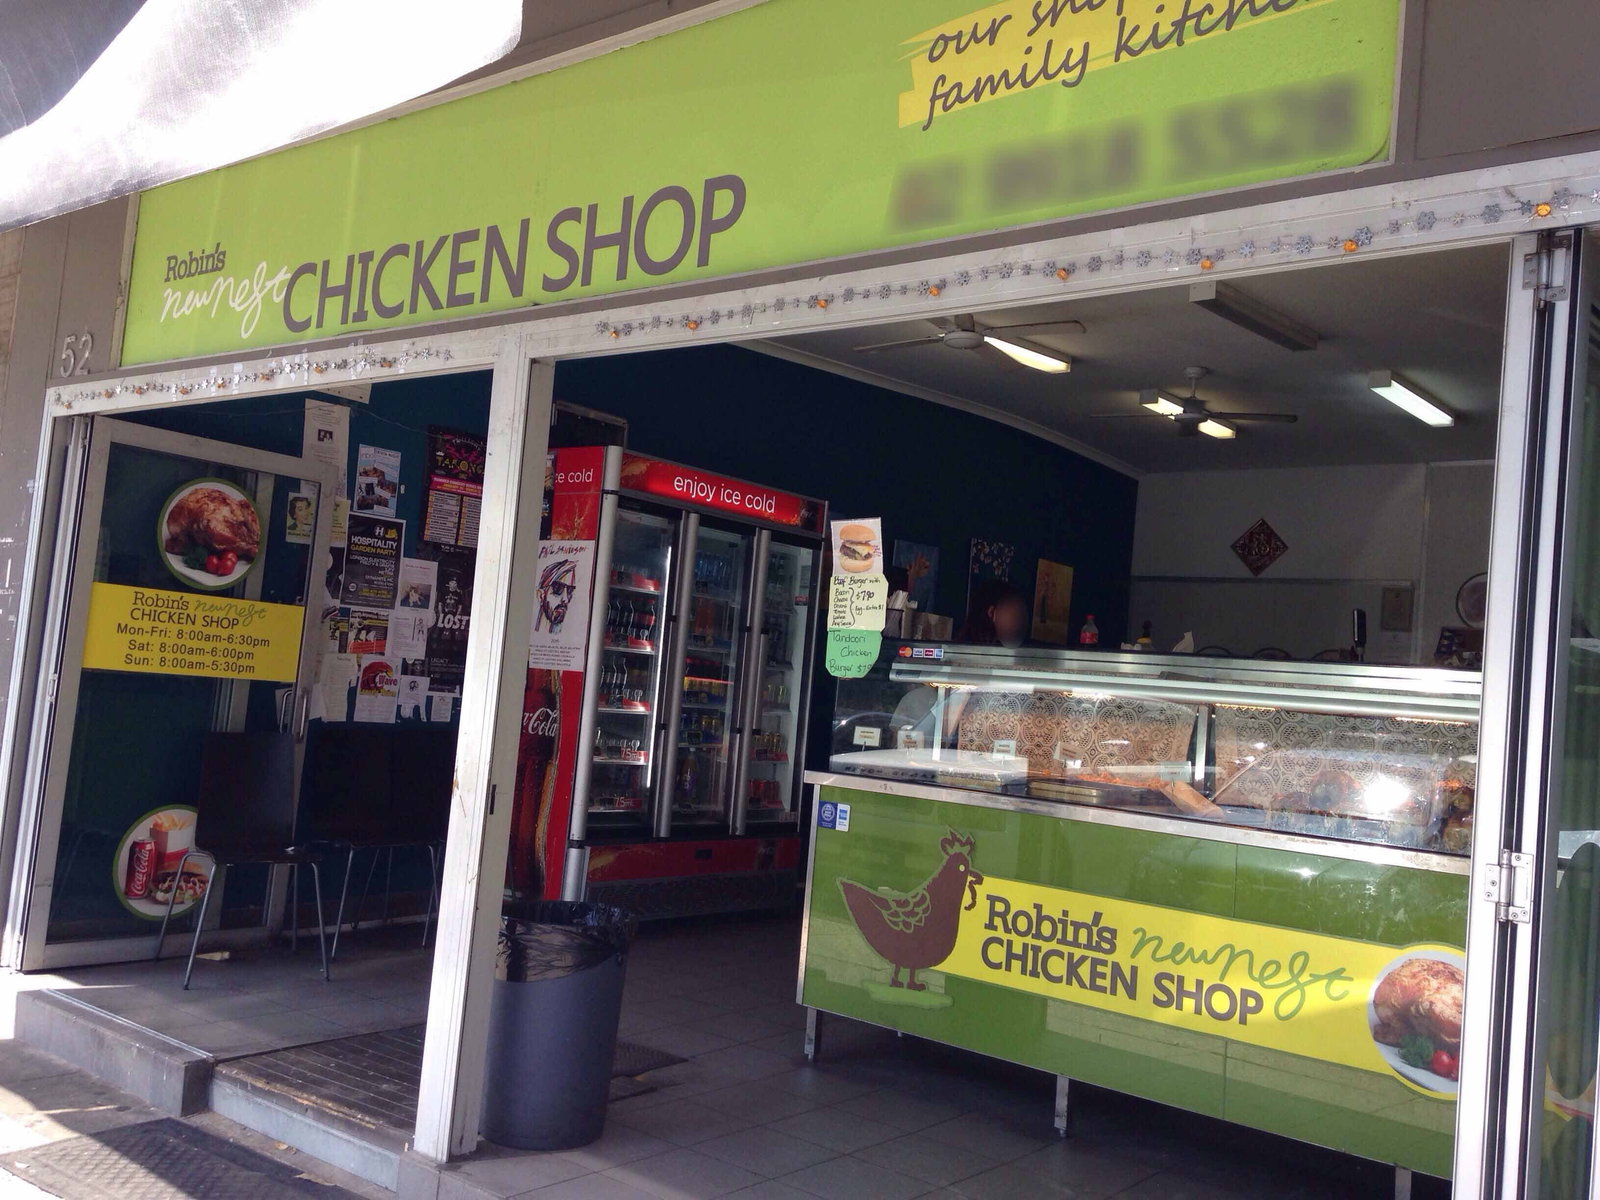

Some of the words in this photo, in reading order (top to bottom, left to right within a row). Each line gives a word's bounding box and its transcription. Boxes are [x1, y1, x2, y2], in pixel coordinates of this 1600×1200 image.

[928, 14, 1012, 63] our
[922, 39, 1089, 131] family
[164, 242, 227, 282] Robin's
[283, 218, 531, 333] CHICKEN
[542, 174, 747, 292] SHOP
[60, 332, 93, 378] 52
[568, 468, 593, 483] cold
[674, 475, 716, 501] enjoy
[720, 483, 741, 505] ice
[745, 494, 776, 513] cold
[351, 535, 397, 550] HOSPITALITY
[351, 545, 375, 553] GARDEN
[376, 548, 396, 556] PARTY
[848, 576, 867, 588] Burger
[132, 591, 189, 610] Robin's
[130, 608, 196, 625] CHICKEN
[201, 615, 239, 629] SHOP
[437, 613, 470, 630] LOST
[117, 622, 172, 639] Mon-Fri:
[176, 628, 270, 647] 8:00am-6:30pm
[829, 630, 866, 643] Tandoori
[128, 639, 155, 652] Sat:
[159, 642, 254, 661] 8:00am-6:00pm
[840, 645, 872, 657] Chicken
[124, 654, 154, 666] Sun:
[159, 657, 255, 674] 8:00am-5:30pm
[828, 659, 853, 677] Burger
[131, 847, 150, 896] Coca-Cola
[984, 894, 1117, 955] Robin's
[980, 936, 1138, 1001] CHICKEN
[1152, 972, 1264, 1026] SHOP
